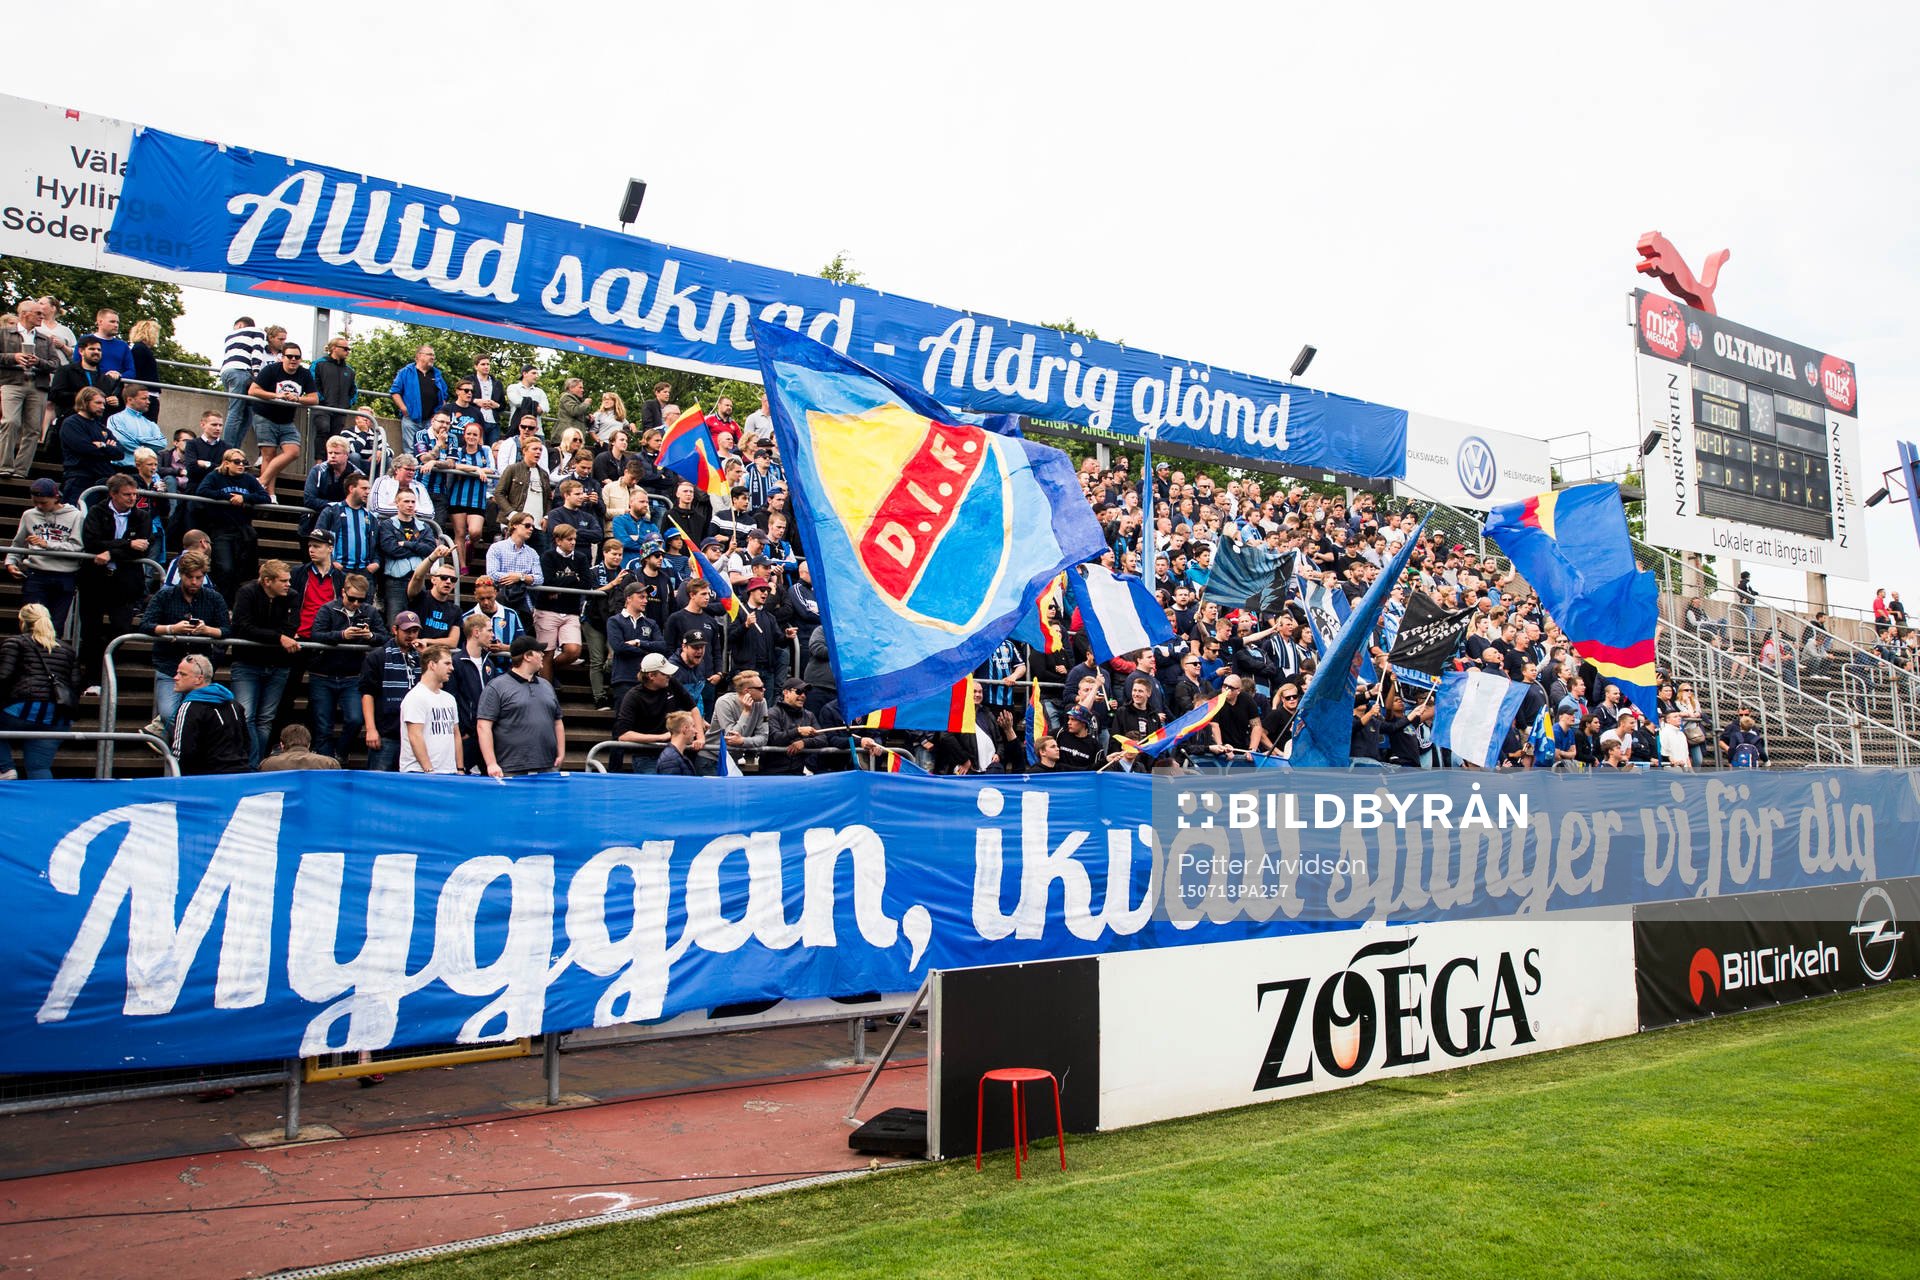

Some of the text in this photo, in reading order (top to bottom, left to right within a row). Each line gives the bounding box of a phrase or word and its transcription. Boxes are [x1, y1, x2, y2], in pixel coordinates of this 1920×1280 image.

[227, 170, 524, 302] Alltid
[918, 317, 1118, 430] Aldrig
[1131, 366, 1292, 451] glömd
[1647, 330, 1679, 353] MEGAPOL
[1714, 331, 1797, 380] OLYMPIA
[1407, 449, 1449, 466] OLKSWAGEN
[1667, 373, 1686, 517] NORRPORTEN
[1503, 469, 1546, 486] HELSINGBORG
[1831, 421, 1848, 549] NORRPORTEN
[1712, 527, 1823, 566] Lokaler att längta till
[35, 791, 932, 1058] Myggan,
[1641, 781, 1697, 888] vi
[1694, 779, 1785, 897] för
[1799, 777, 1877, 881] dig
[1723, 940, 1839, 991] BilCirkeln
